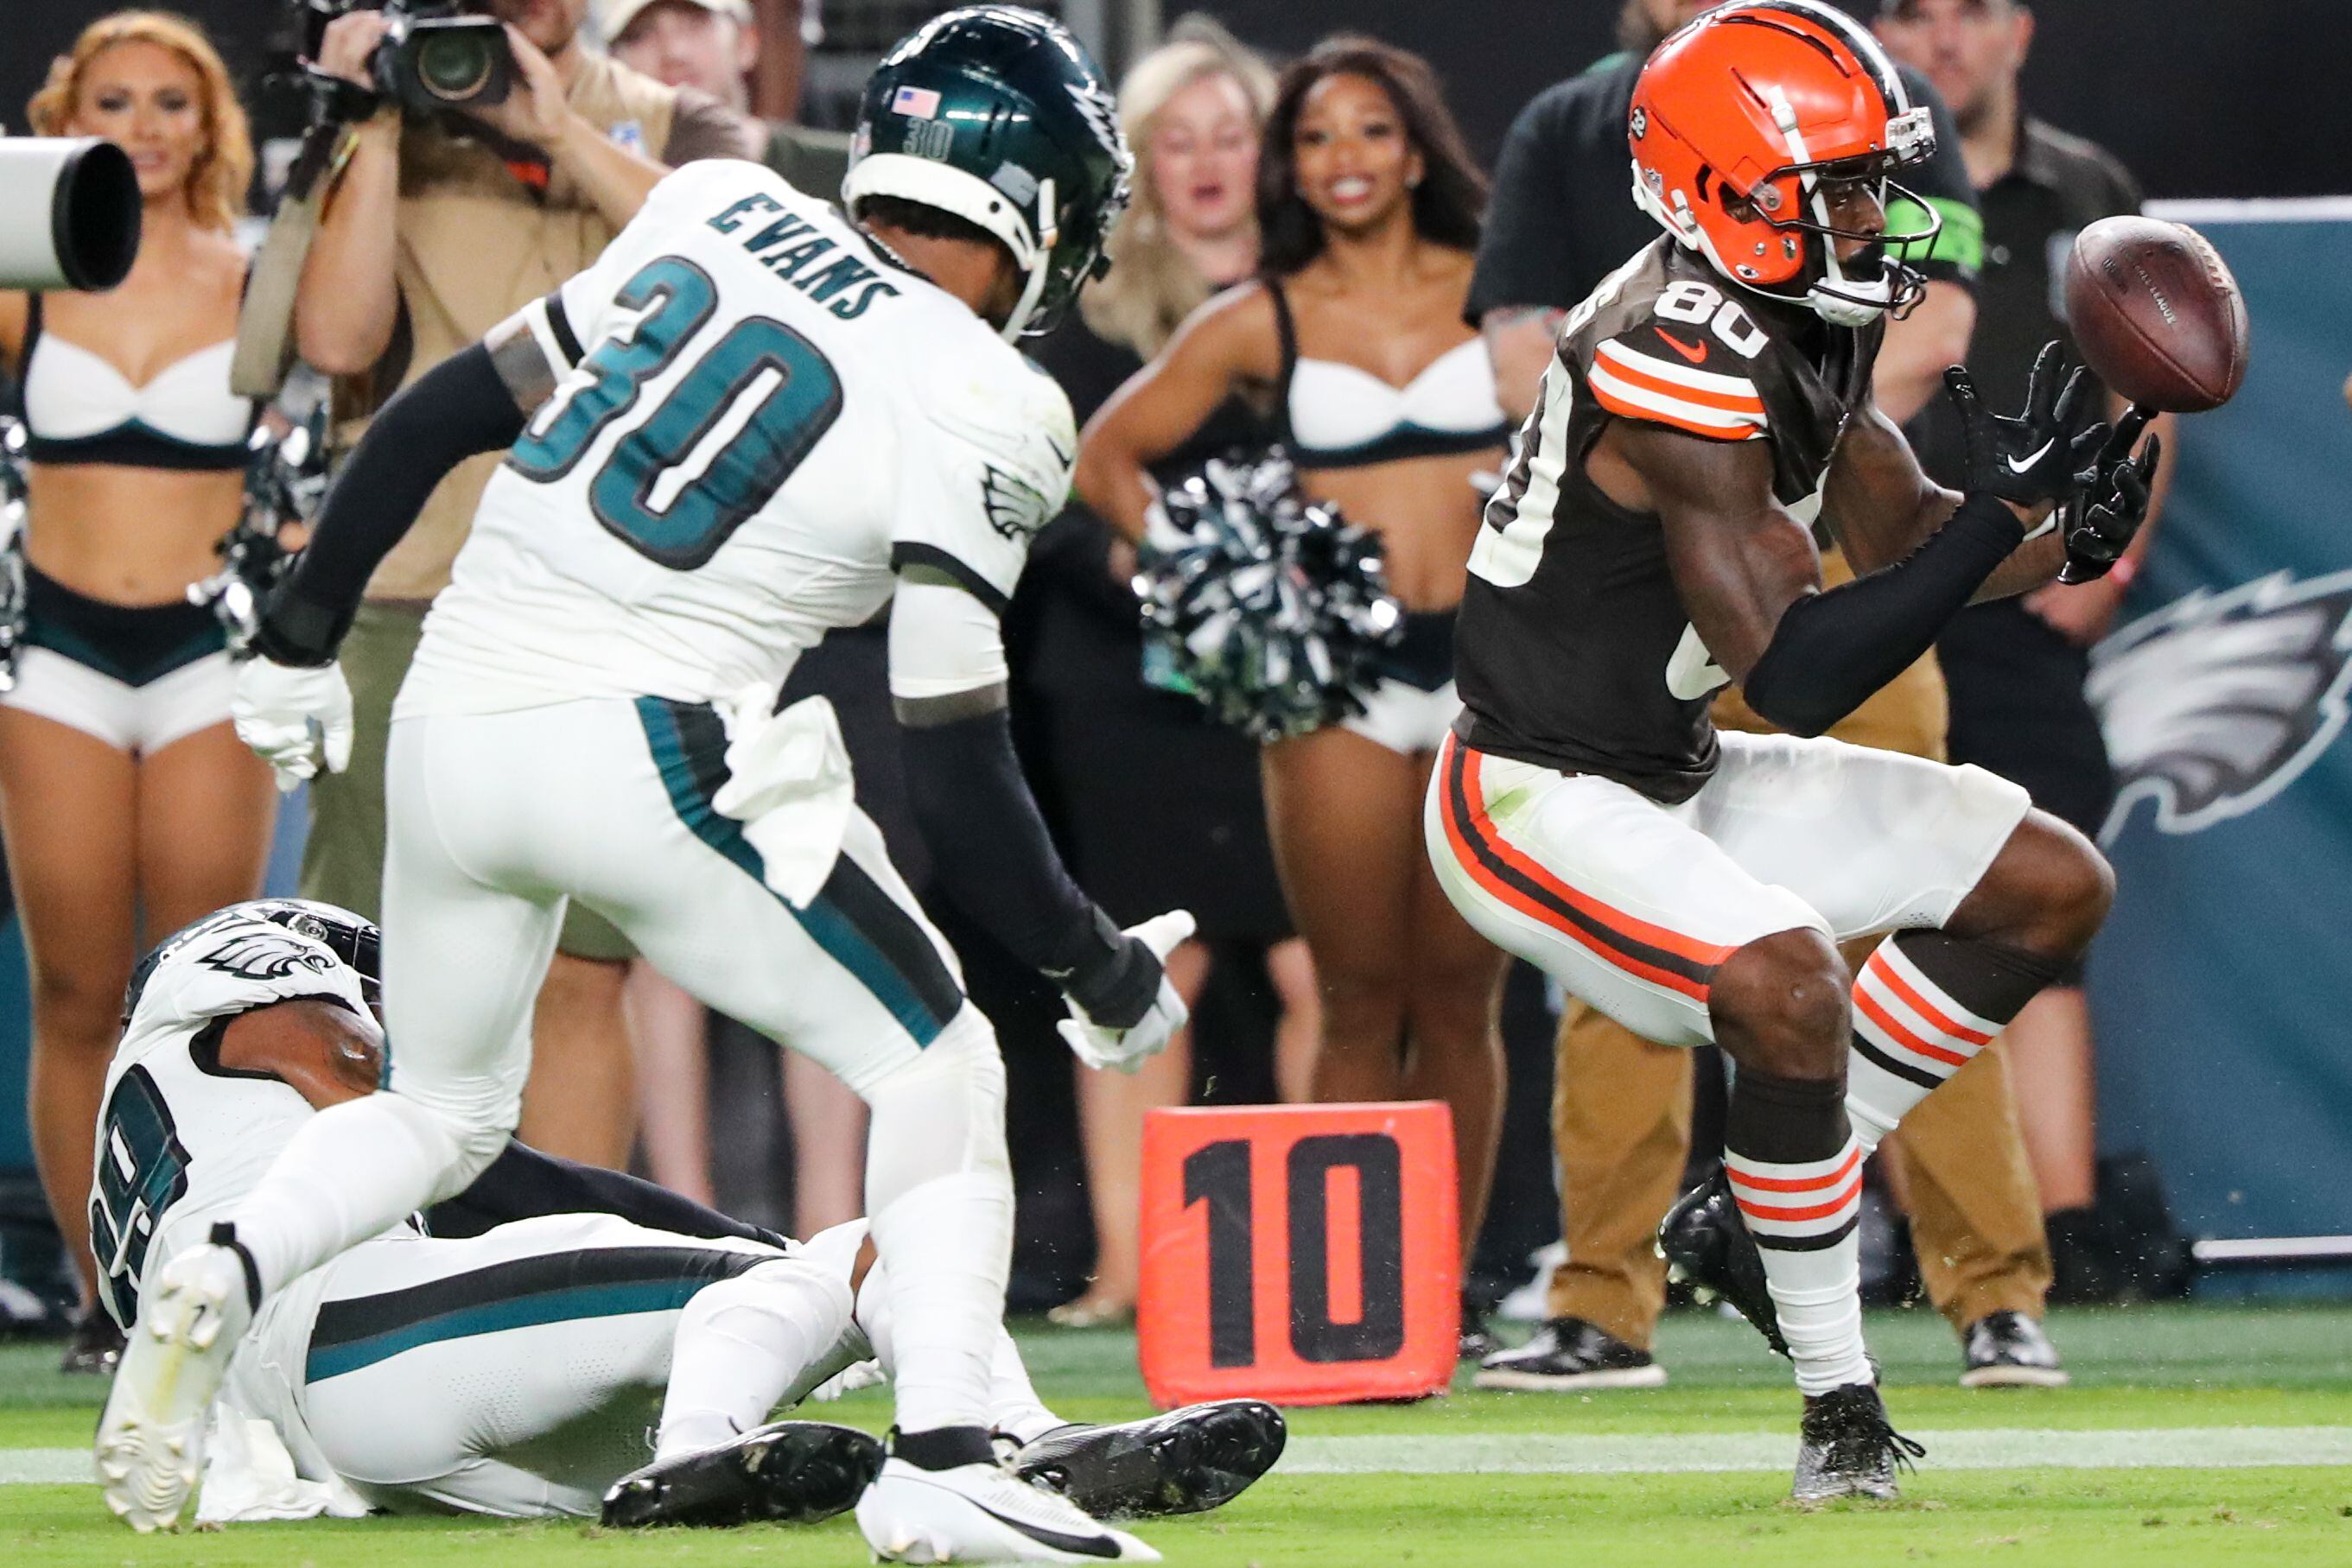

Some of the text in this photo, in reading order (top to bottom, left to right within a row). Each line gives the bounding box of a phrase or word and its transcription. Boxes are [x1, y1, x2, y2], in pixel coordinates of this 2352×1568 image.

[902, 117, 956, 162] 30
[705, 192, 903, 321] EVANS
[1653, 280, 1770, 359] 80
[505, 254, 844, 572] 30
[1183, 1133, 1406, 1368] 10
